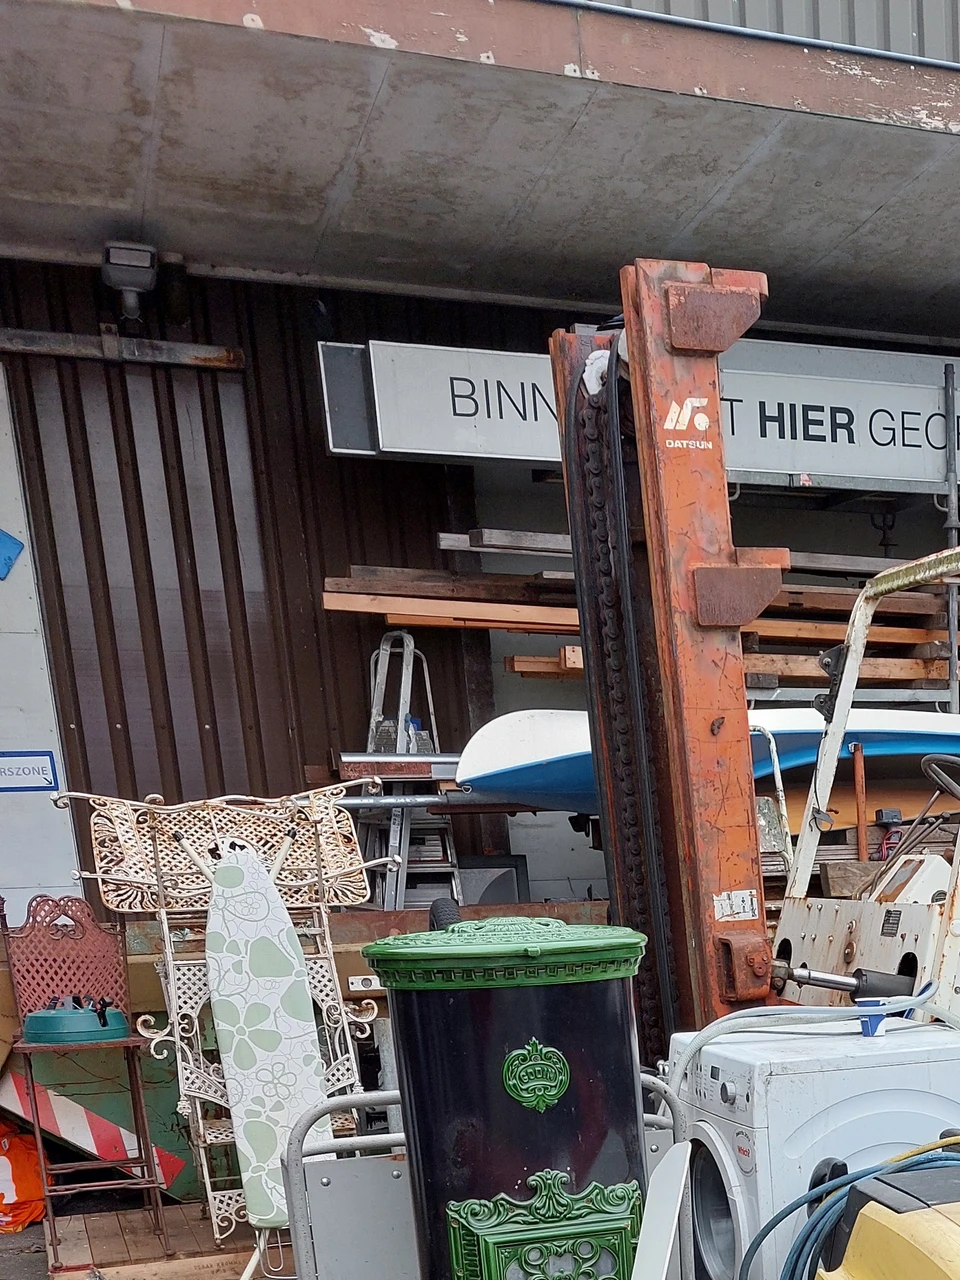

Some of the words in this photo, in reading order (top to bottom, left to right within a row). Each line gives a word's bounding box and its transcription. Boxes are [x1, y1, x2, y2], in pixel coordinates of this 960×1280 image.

[449, 376, 558, 422] BINN
[758, 400, 856, 444] HIER
[665, 440, 713, 449] DATSUN
[0, 766, 49, 777] RSZONE
[519, 1067, 556, 1083] GODIN
